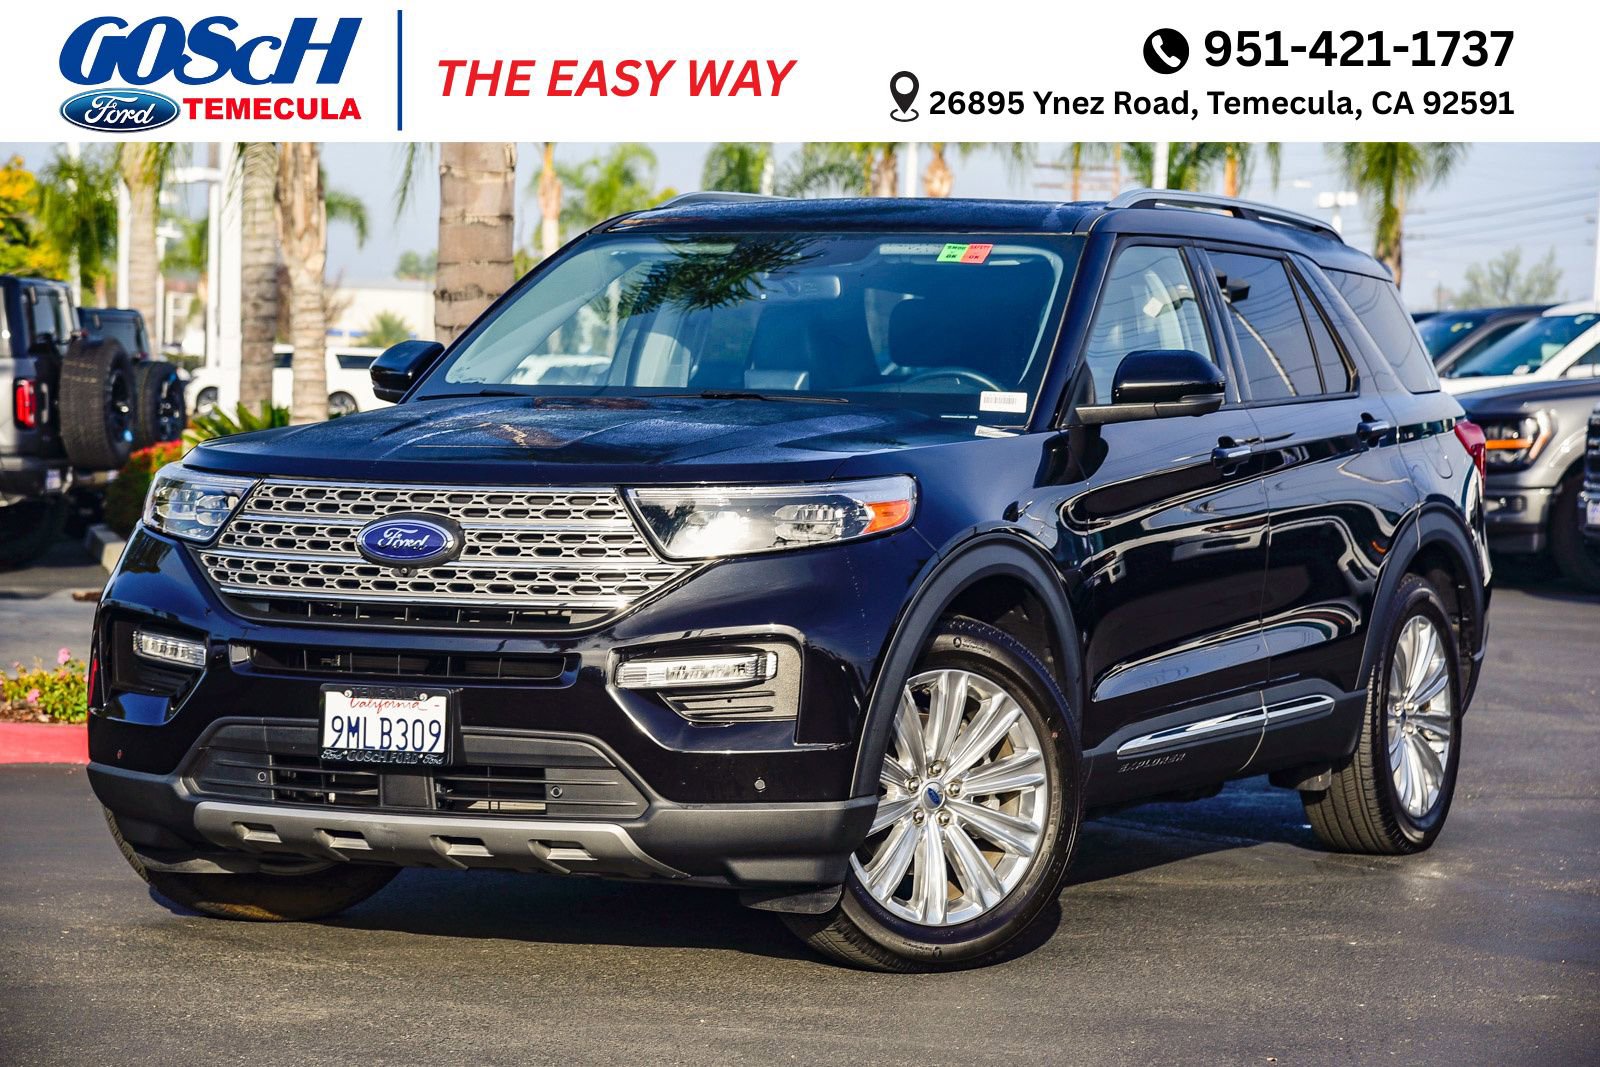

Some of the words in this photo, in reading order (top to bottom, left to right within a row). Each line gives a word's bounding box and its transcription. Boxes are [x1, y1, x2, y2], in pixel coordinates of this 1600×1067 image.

[377, 527, 430, 550] Ford
[349, 697, 425, 714] California
[331, 715, 442, 752] 9MLB309
